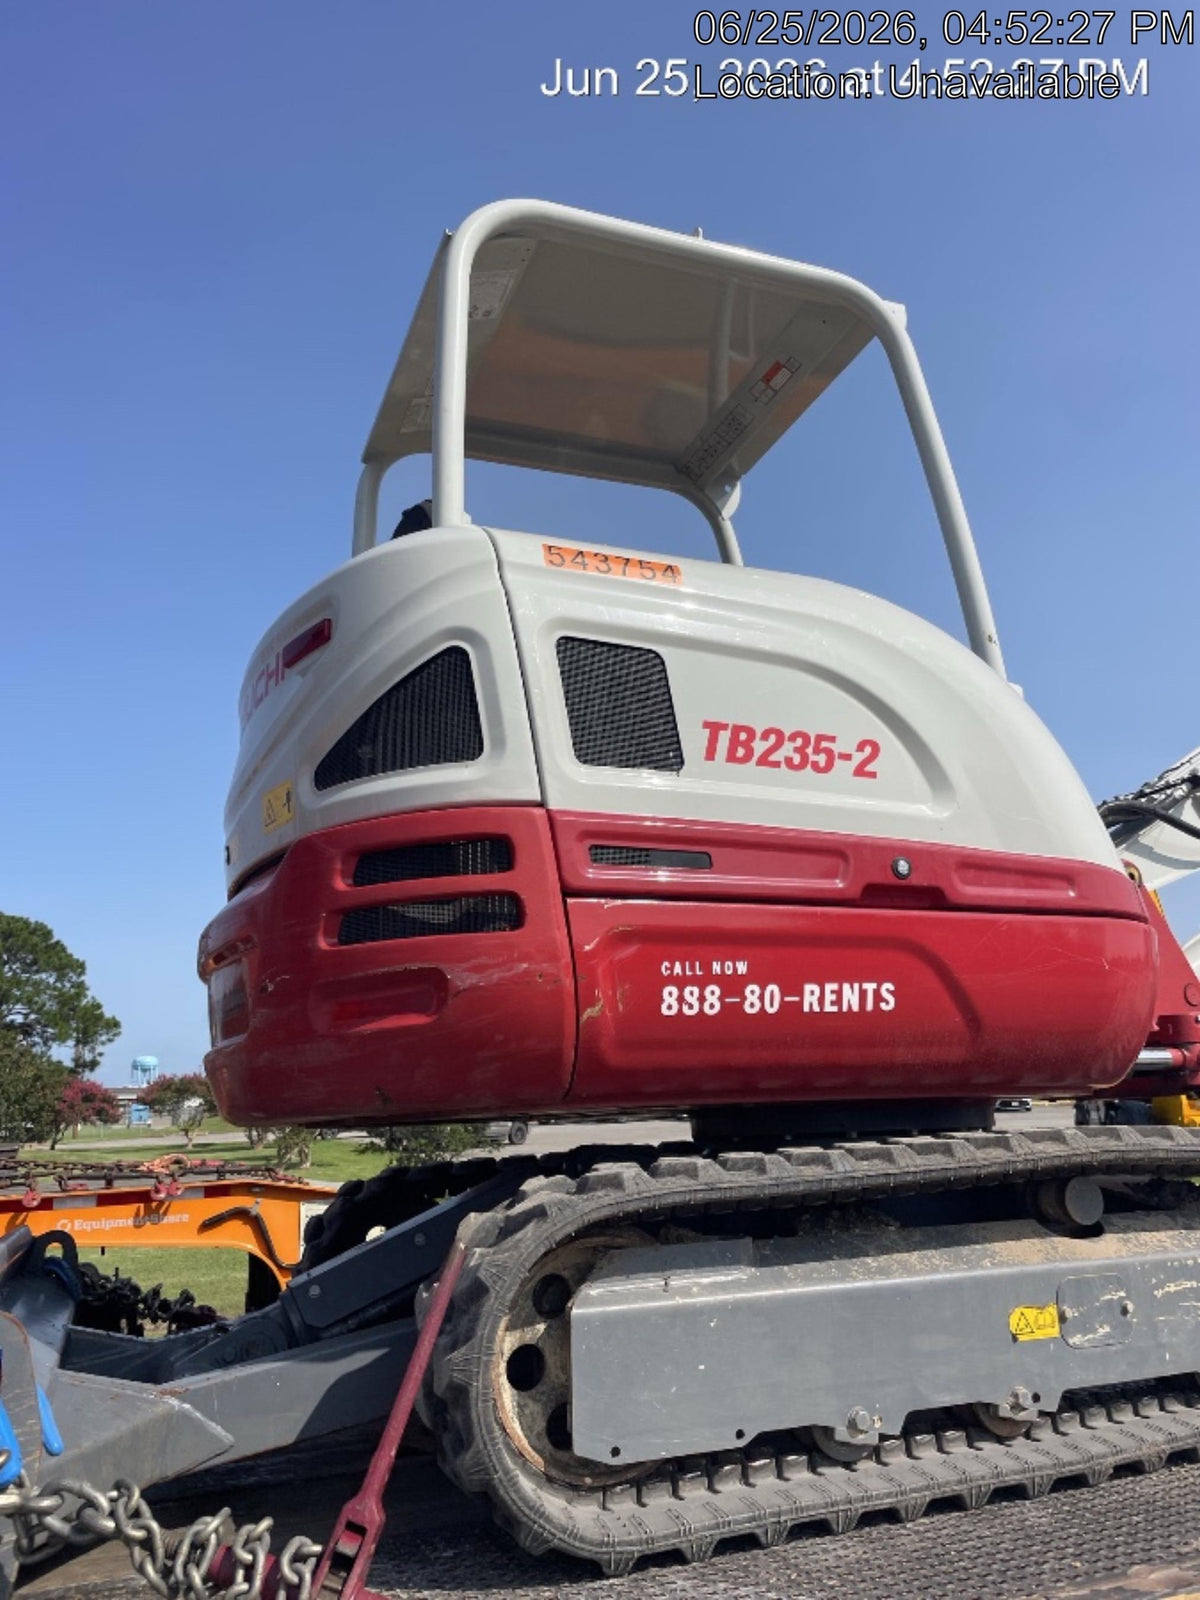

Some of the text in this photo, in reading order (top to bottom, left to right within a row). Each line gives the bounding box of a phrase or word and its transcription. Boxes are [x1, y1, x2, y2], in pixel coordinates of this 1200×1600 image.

[547, 545, 678, 584] 543754
[702, 720, 881, 779] TB235-2
[660, 960, 749, 977] CALL NOW
[660, 982, 897, 1017] 888-80-RENTS
[73, 1213, 190, 1232] EquipmentShare
